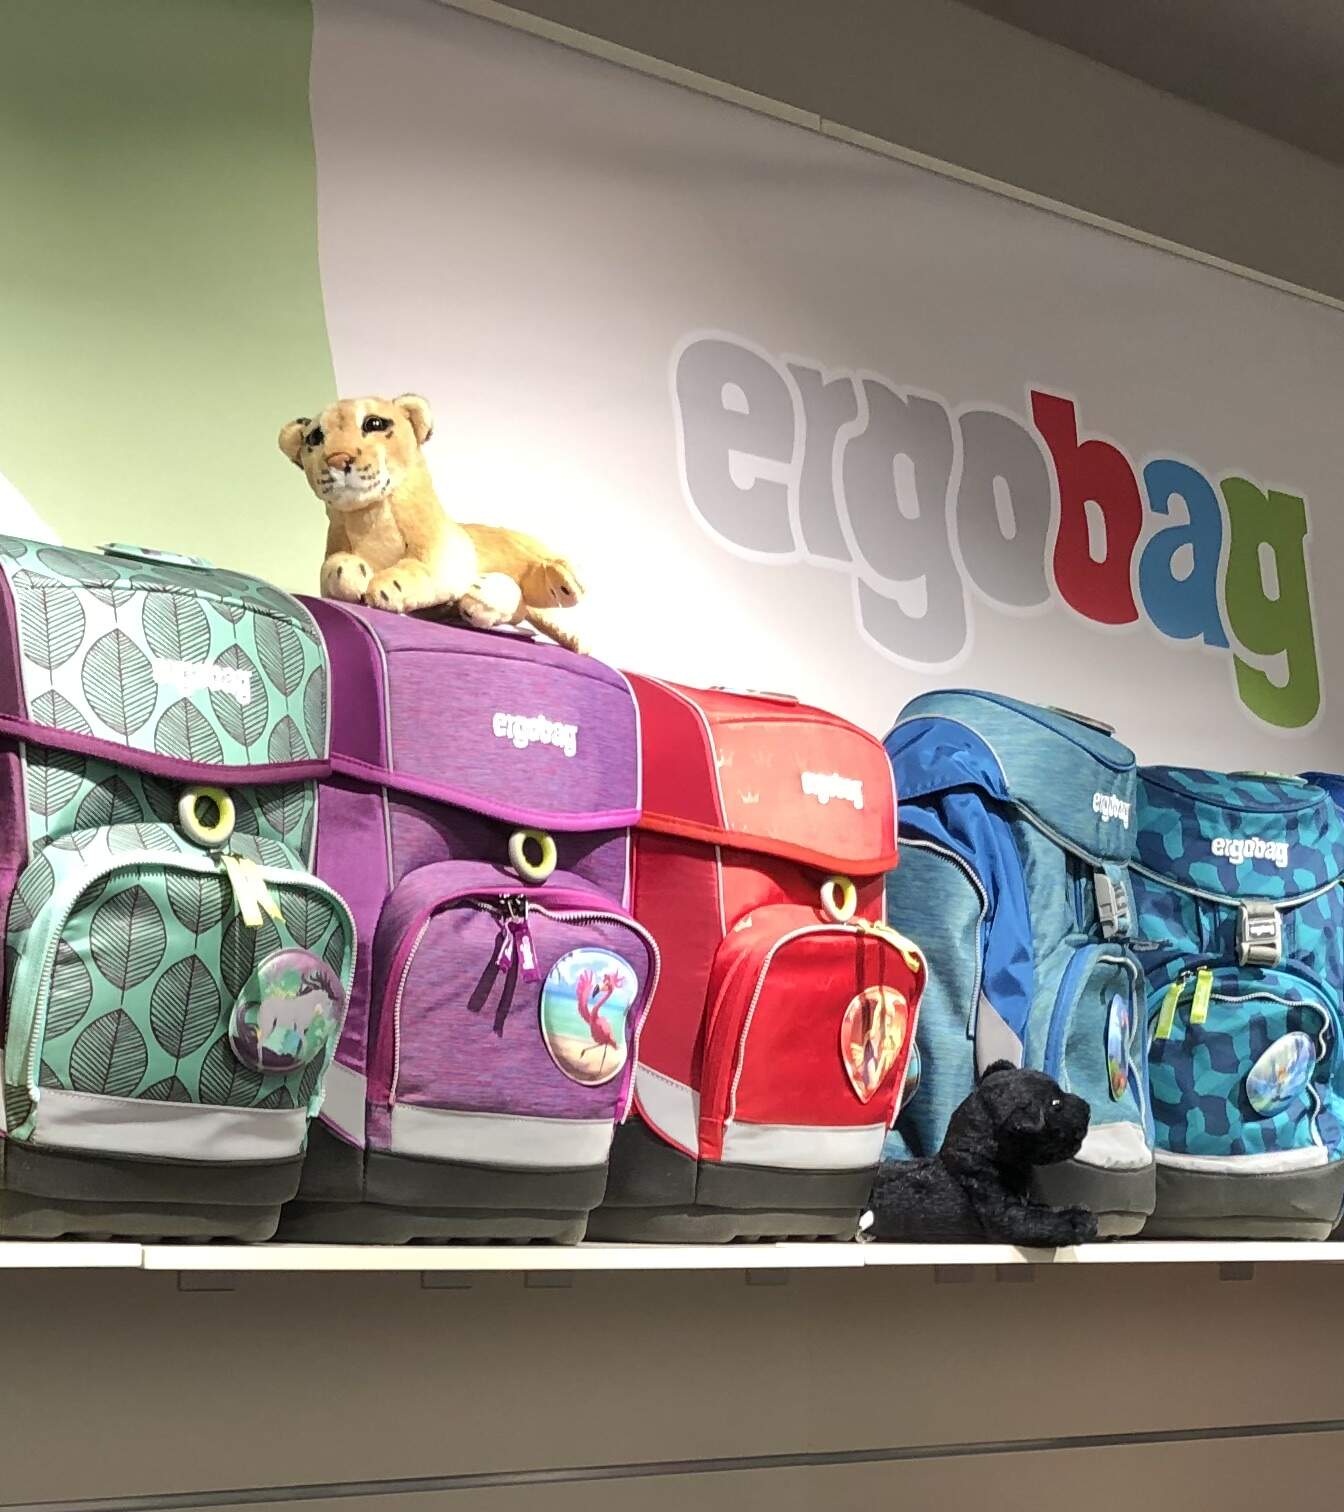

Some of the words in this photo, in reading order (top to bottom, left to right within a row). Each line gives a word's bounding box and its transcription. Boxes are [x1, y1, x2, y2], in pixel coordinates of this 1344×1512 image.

[674, 337, 1321, 729] ergobag
[492, 710, 578, 755] ergobag
[801, 770, 864, 810] ergobag
[1092, 792, 1130, 829] ergobag
[1211, 837, 1289, 867] ergobag
